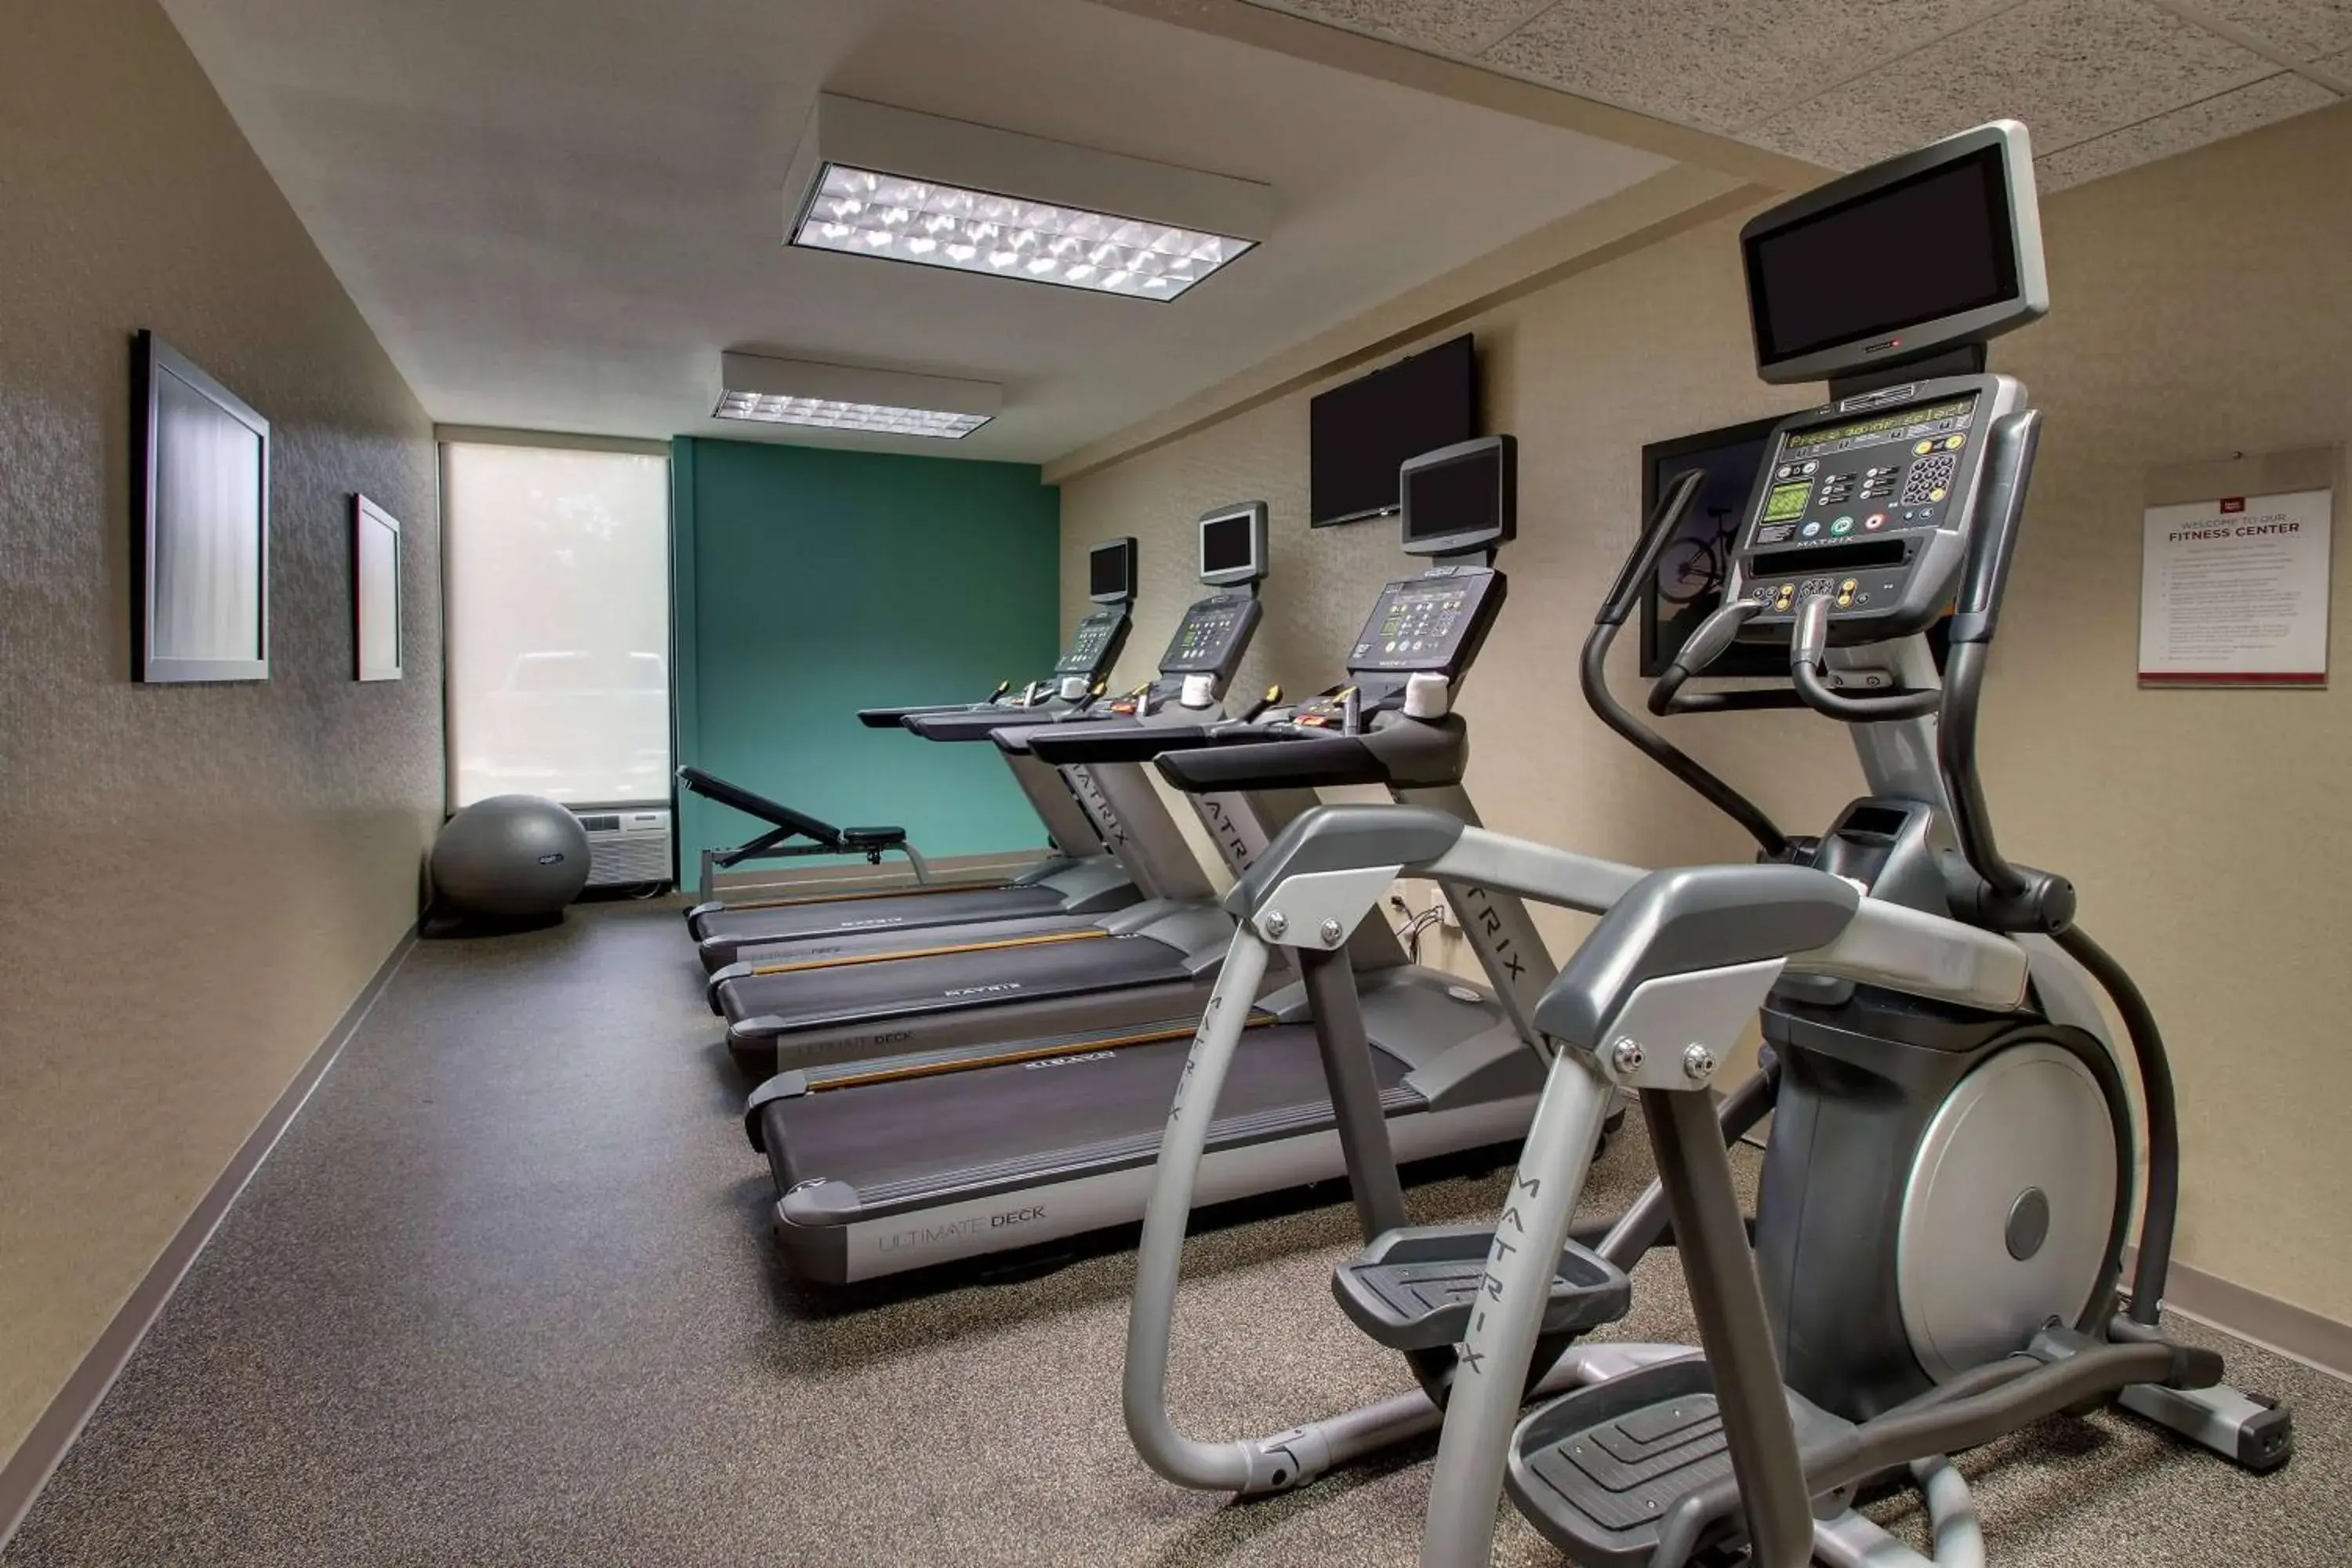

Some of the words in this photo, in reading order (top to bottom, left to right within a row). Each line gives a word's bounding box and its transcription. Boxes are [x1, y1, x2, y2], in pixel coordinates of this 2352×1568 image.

[2169, 528, 2230, 542] FITNESS
[2235, 523, 2299, 537] CENTER
[2181, 518, 2235, 530] WELCOME
[2243, 516, 2257, 524] TO
[2260, 514, 2287, 523] OUR
[1202, 795, 1254, 871] ATRI
[1467, 887, 1526, 982] TRIX
[873, 1030, 916, 1045] DECK
[878, 1216, 985, 1252] ULTIMATE
[990, 1205, 1047, 1228] DECK
[1461, 1168, 1541, 1375] MATRIX
